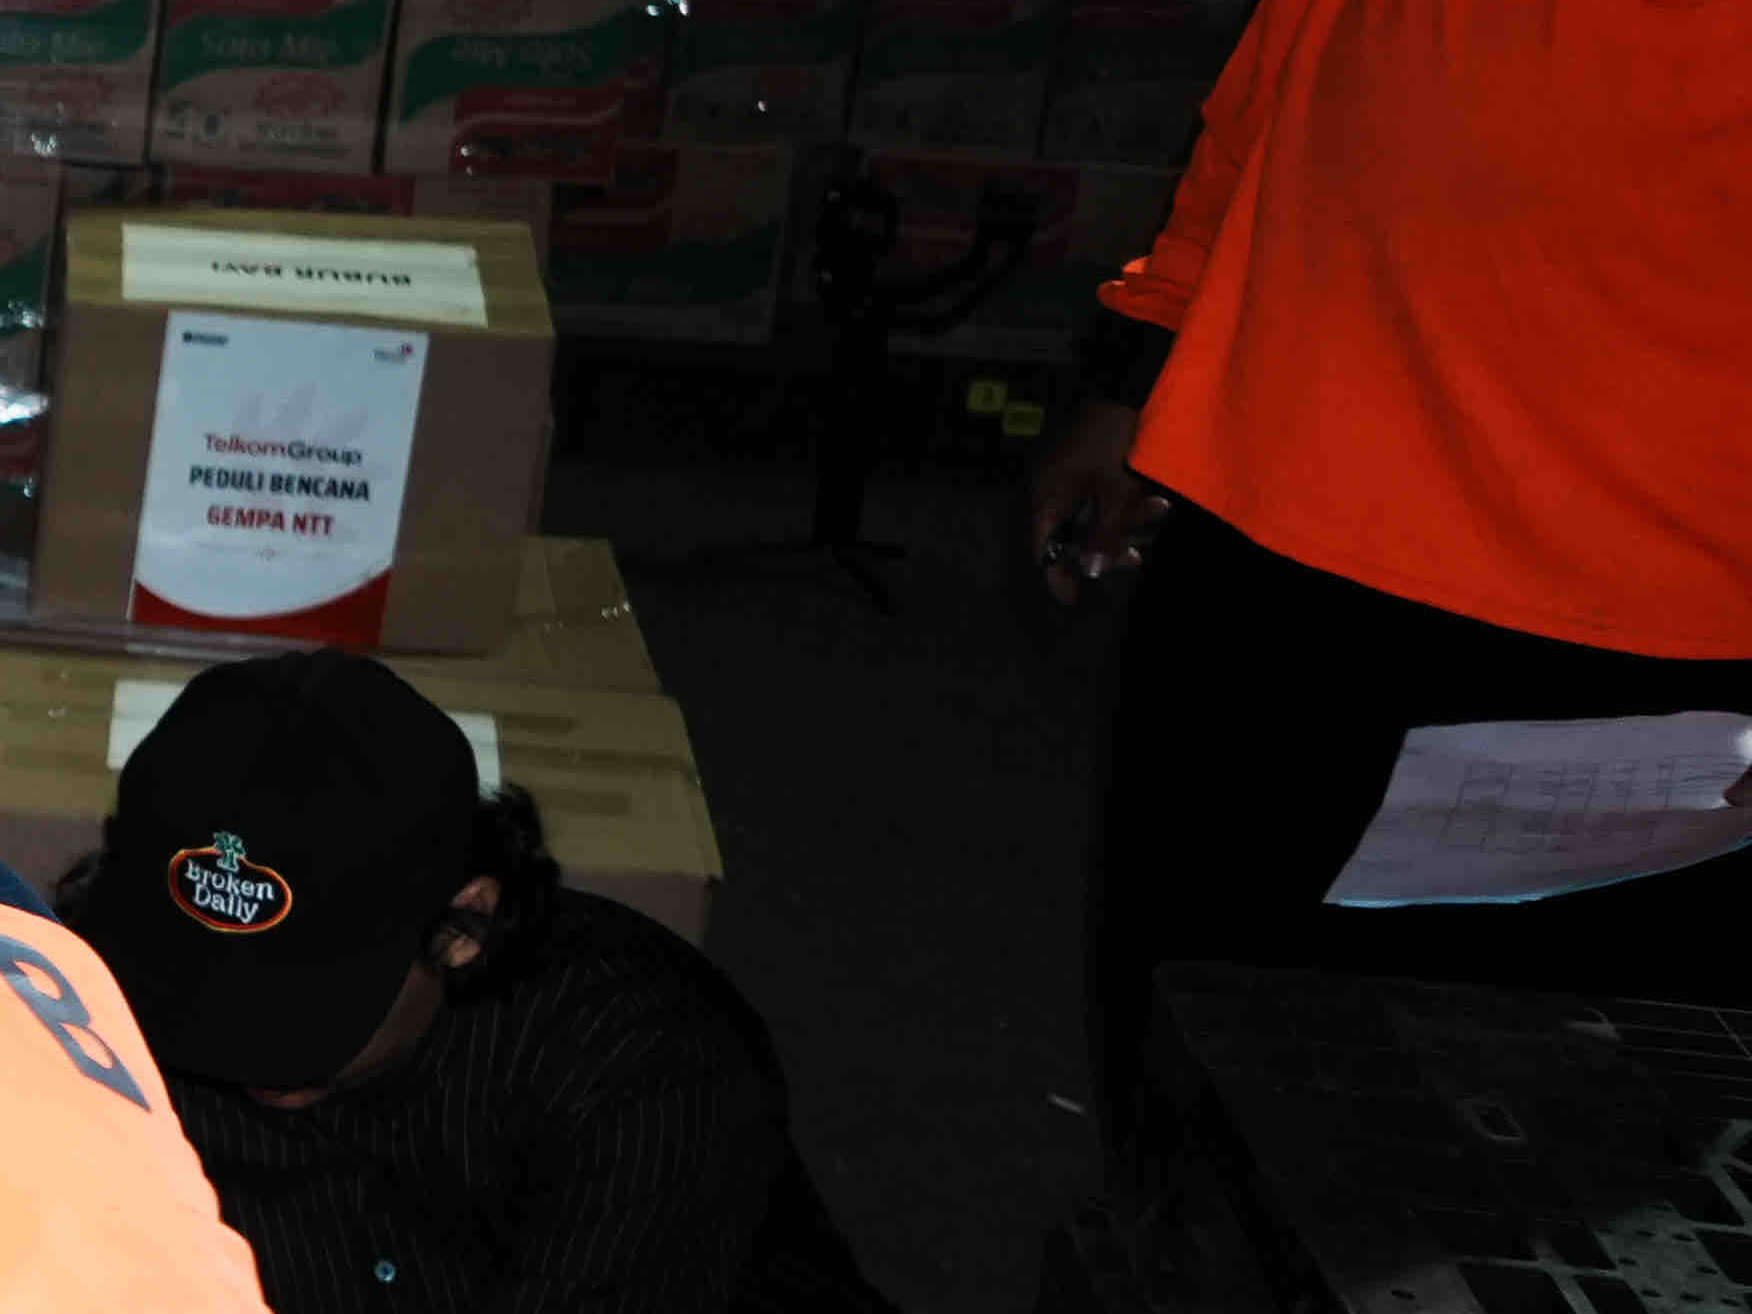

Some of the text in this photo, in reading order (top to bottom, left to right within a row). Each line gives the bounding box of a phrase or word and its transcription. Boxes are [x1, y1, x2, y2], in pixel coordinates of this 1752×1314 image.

[205, 433, 363, 468] TelkomGroup
[189, 463, 371, 502] PEDULI BENCANA
[206, 503, 336, 537] GEMPA NTT
